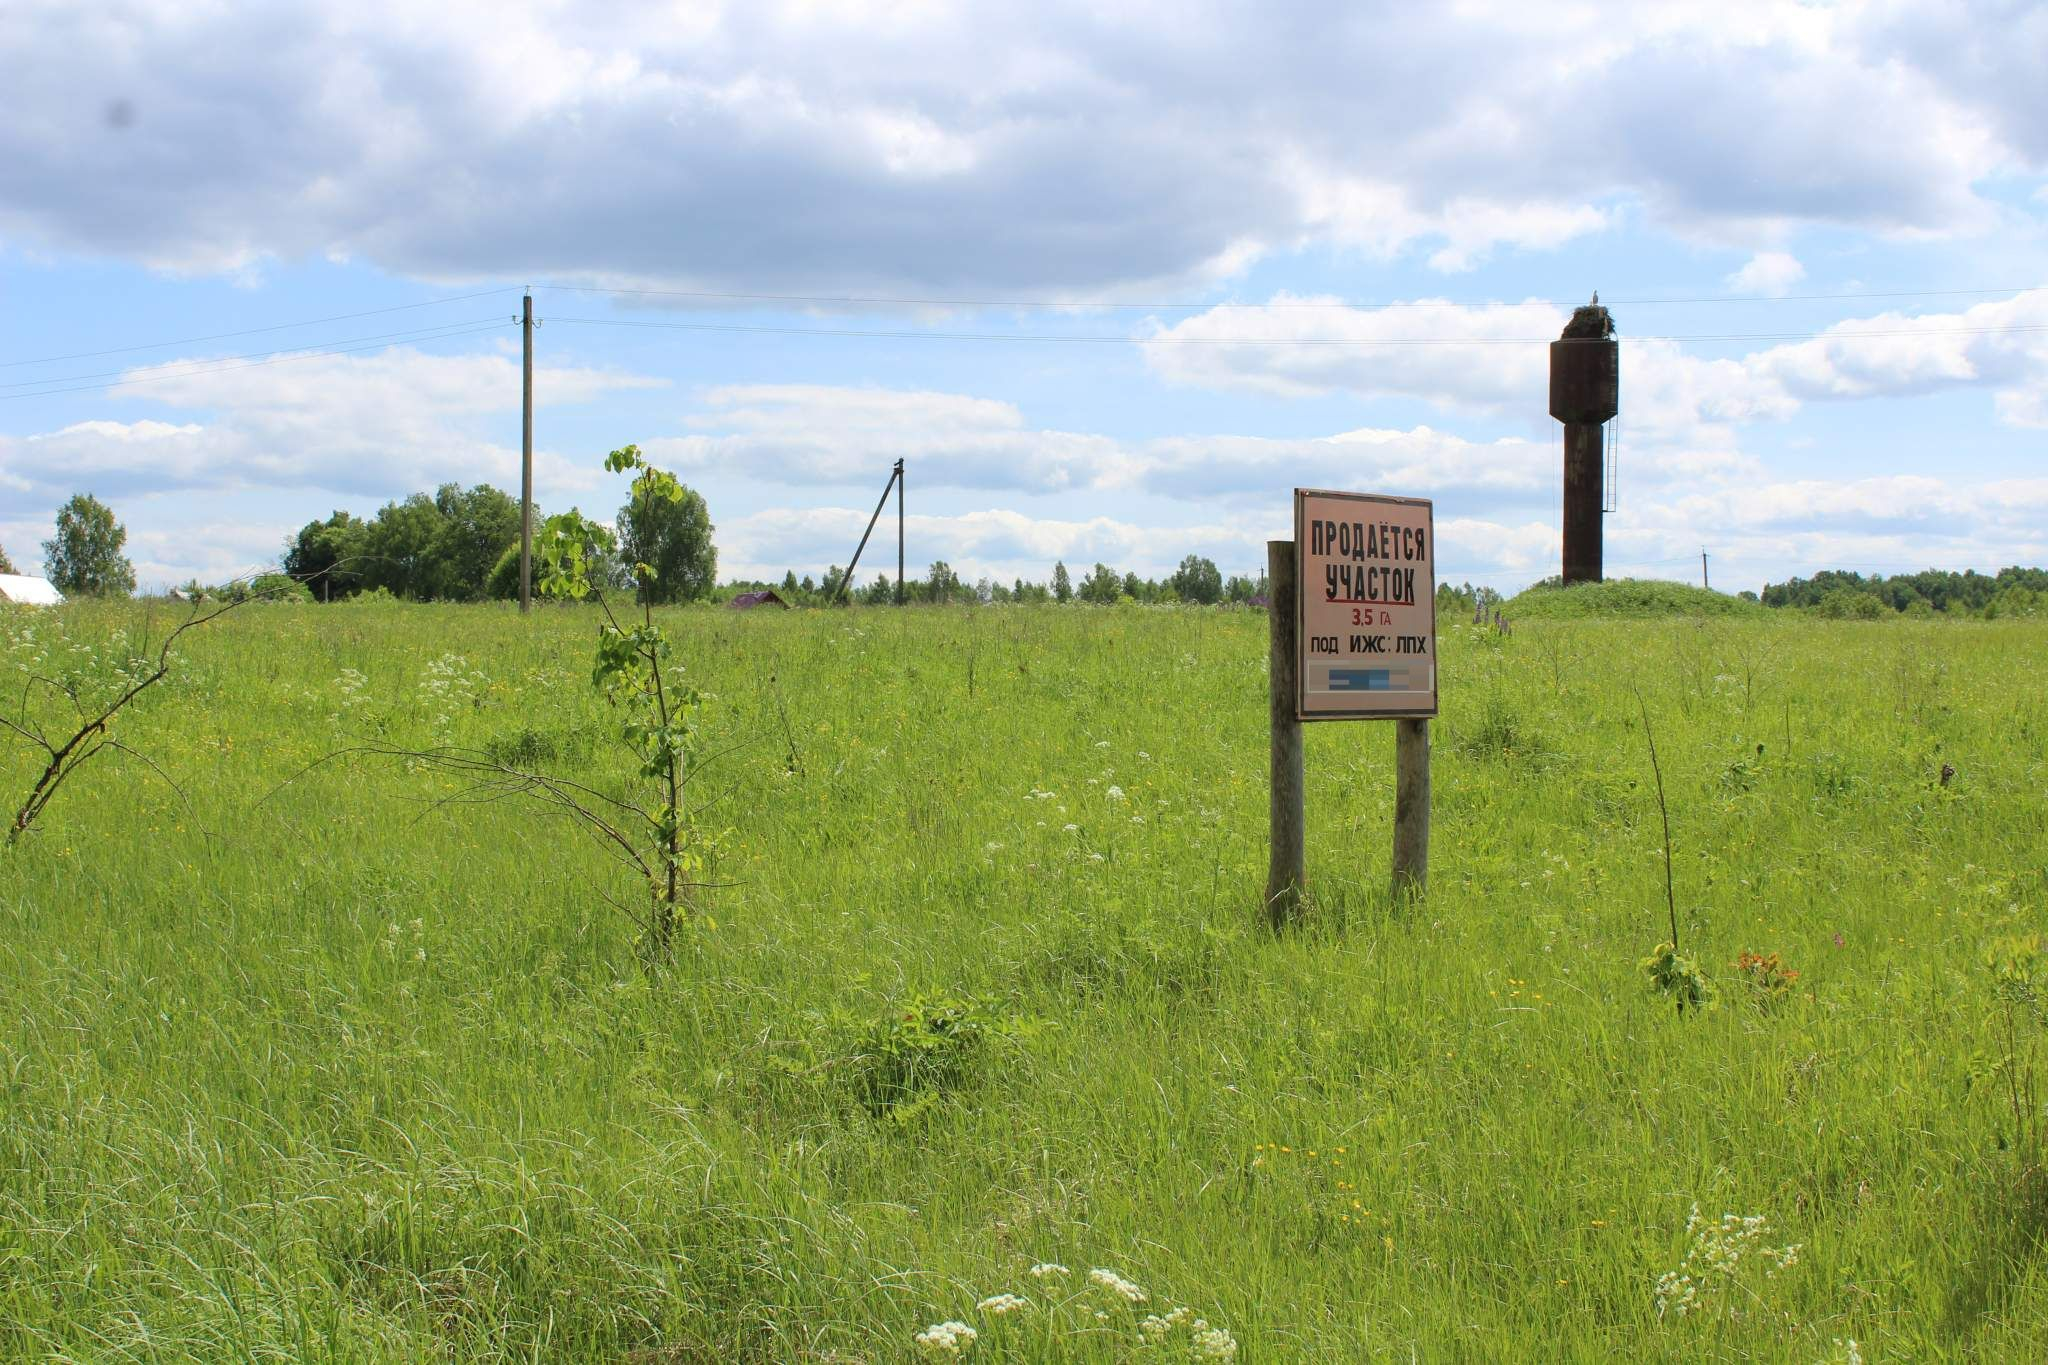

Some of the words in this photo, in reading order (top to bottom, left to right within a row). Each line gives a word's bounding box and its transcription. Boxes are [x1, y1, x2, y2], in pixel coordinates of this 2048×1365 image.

[1311, 520, 1425, 562] ПРОДАЁТСЯ
[1326, 564, 1415, 603] УЧАСТОК
[1352, 608, 1373, 626] 3,5
[1380, 611, 1392, 625] ГА
[1396, 636, 1426, 653] ЛПХ
